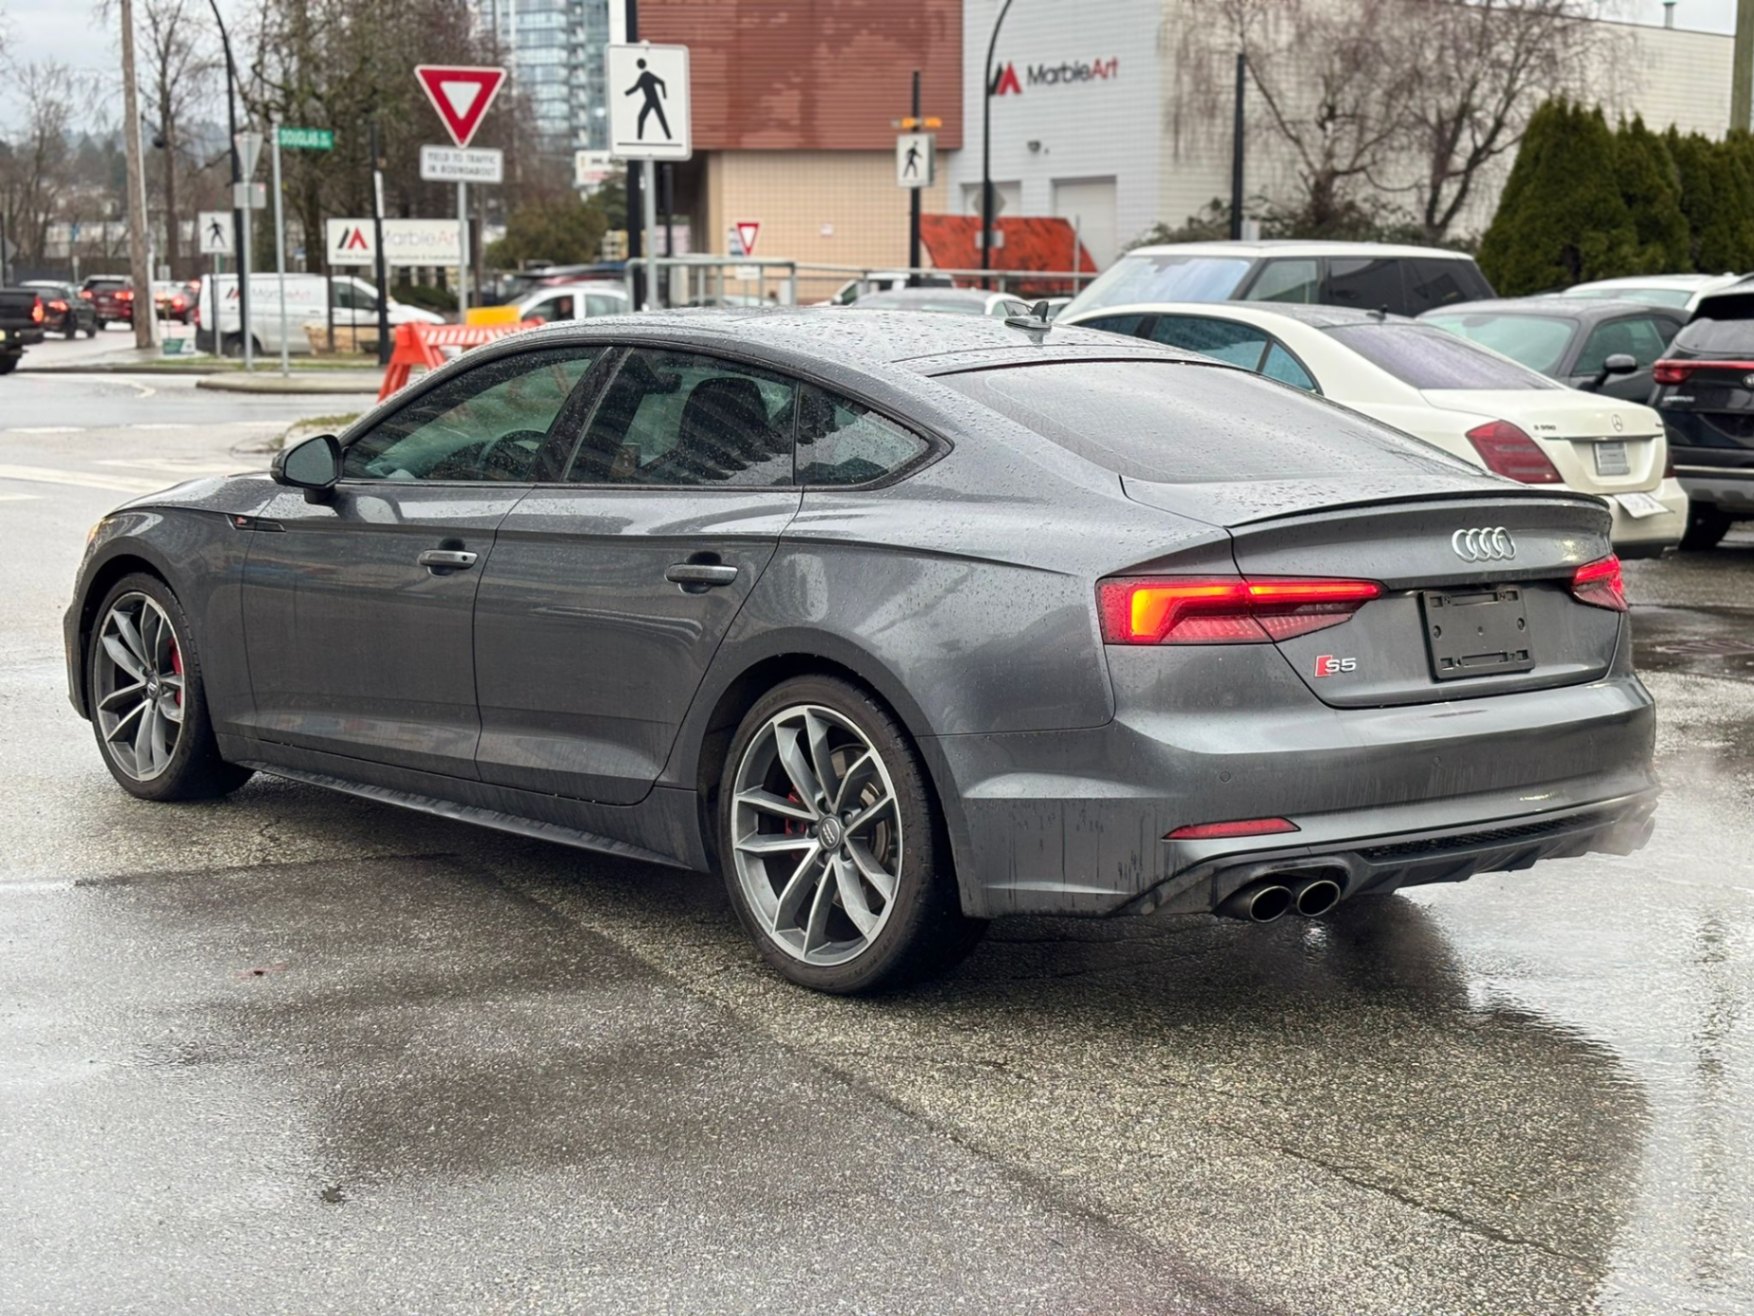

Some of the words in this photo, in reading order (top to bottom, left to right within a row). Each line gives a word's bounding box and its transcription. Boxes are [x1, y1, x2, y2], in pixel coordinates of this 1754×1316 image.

[1027, 57, 1118, 85] MarbleArt
[427, 152, 450, 163] YIELD
[453, 153, 464, 163] TO
[466, 154, 497, 165] TRAFFIC
[1323, 657, 1357, 674] S5
